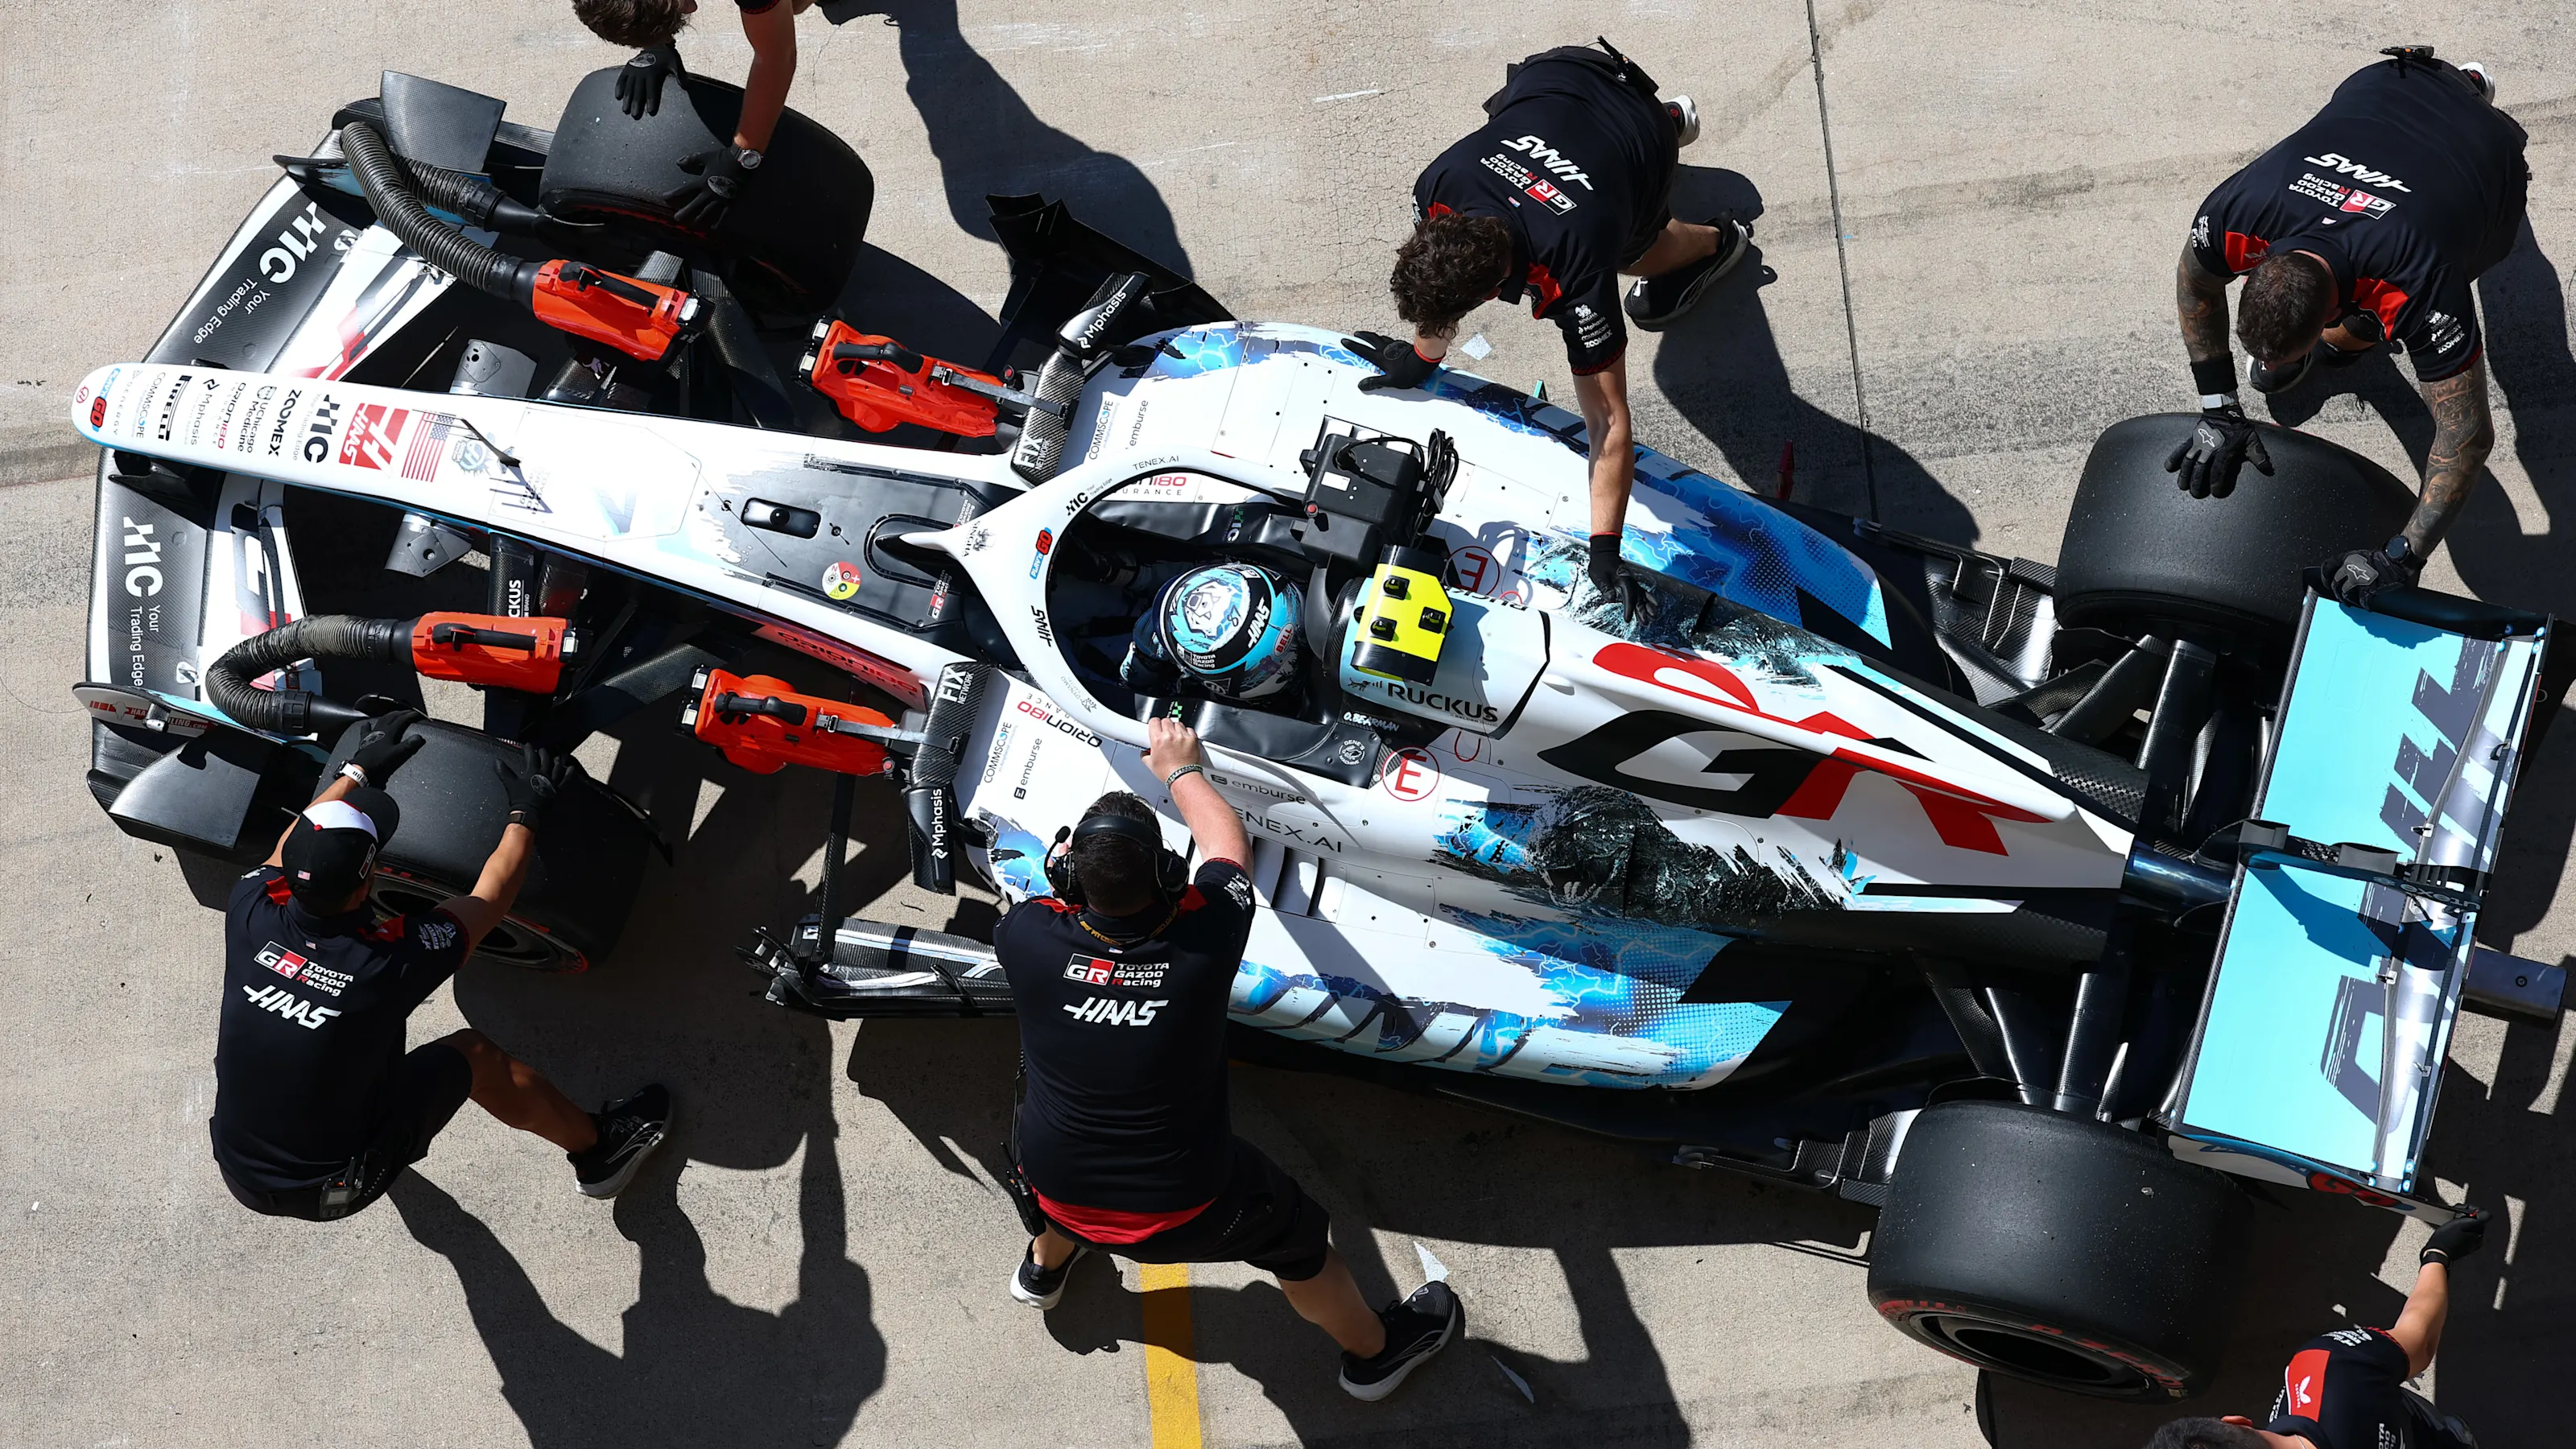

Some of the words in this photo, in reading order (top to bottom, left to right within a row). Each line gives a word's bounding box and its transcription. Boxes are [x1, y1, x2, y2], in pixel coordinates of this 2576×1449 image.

[1480, 158, 1525, 189] TOYOTA
[1489, 157, 1532, 185] GAZOO
[1496, 153, 1538, 180] Racing
[1501, 135, 1594, 190] HAAS
[2303, 152, 2412, 192] HAAS
[1535, 181, 1572, 209] GR
[2289, 184, 2339, 207] TOYOTA
[2297, 179, 2346, 201] GAZOO
[2302, 172, 2351, 195] Racing
[2349, 192, 2392, 212] GR
[217, 278, 258, 316] Trading
[245, 290, 270, 314] Your
[193, 316, 222, 344] Edge
[1084, 291, 1127, 340] Mphasis
[90, 397, 107, 427] GO
[136, 372, 166, 439] COMMSCOPE
[159, 375, 192, 441] PIRELLI
[191, 394, 213, 445] Mphasis
[237, 401, 259, 452] Medicine
[247, 402, 268, 453] UChicago
[268, 389, 302, 456] ZOOMEX
[297, 411, 313, 439] Trading
[343, 409, 369, 466] HAAS
[1088, 400, 1114, 460] COMMSCOPE
[1129, 400, 1149, 446] emburse
[293, 440, 303, 460] Edge
[1013, 433, 1044, 469] FIX
[1133, 455, 1179, 471] TENEX.AI
[1122, 488, 1182, 496] URANCE
[966, 505, 975, 522] acing
[964, 521, 980, 557] SINGHA
[1036, 530, 1053, 555] GO
[508, 580, 521, 617] CKUS
[931, 598, 944, 619] GR
[130, 606, 143, 650] Trading
[149, 605, 160, 632] Your
[1030, 605, 1054, 647] HAAS
[1248, 597, 1270, 648] HAAS
[1275, 628, 1293, 653] BELL
[131, 654, 144, 686] Edge
[938, 667, 966, 703] FIX
[957, 672, 975, 704] NETWORK
[1388, 682, 1498, 722] RUCKUS
[1344, 712, 1400, 732] O.BEARMAN
[984, 721, 1012, 783] COMMSCOPE
[1020, 738, 1042, 786] emburse
[1395, 753, 1427, 795] E
[1232, 780, 1306, 805] emburse
[931, 788, 947, 847] Mphasis
[1232, 806, 1341, 852] ENEX.AI
[258, 951, 299, 976] GR
[308, 961, 354, 982] TOYOTA
[301, 968, 346, 989] GAZOO
[1067, 964, 1108, 983] GR
[1114, 970, 1163, 978] GAZOO
[295, 974, 341, 997] Racing
[1111, 978, 1162, 988] Racing
[242, 985, 342, 1030] HAAS
[1063, 997, 1170, 1026] HAAS
